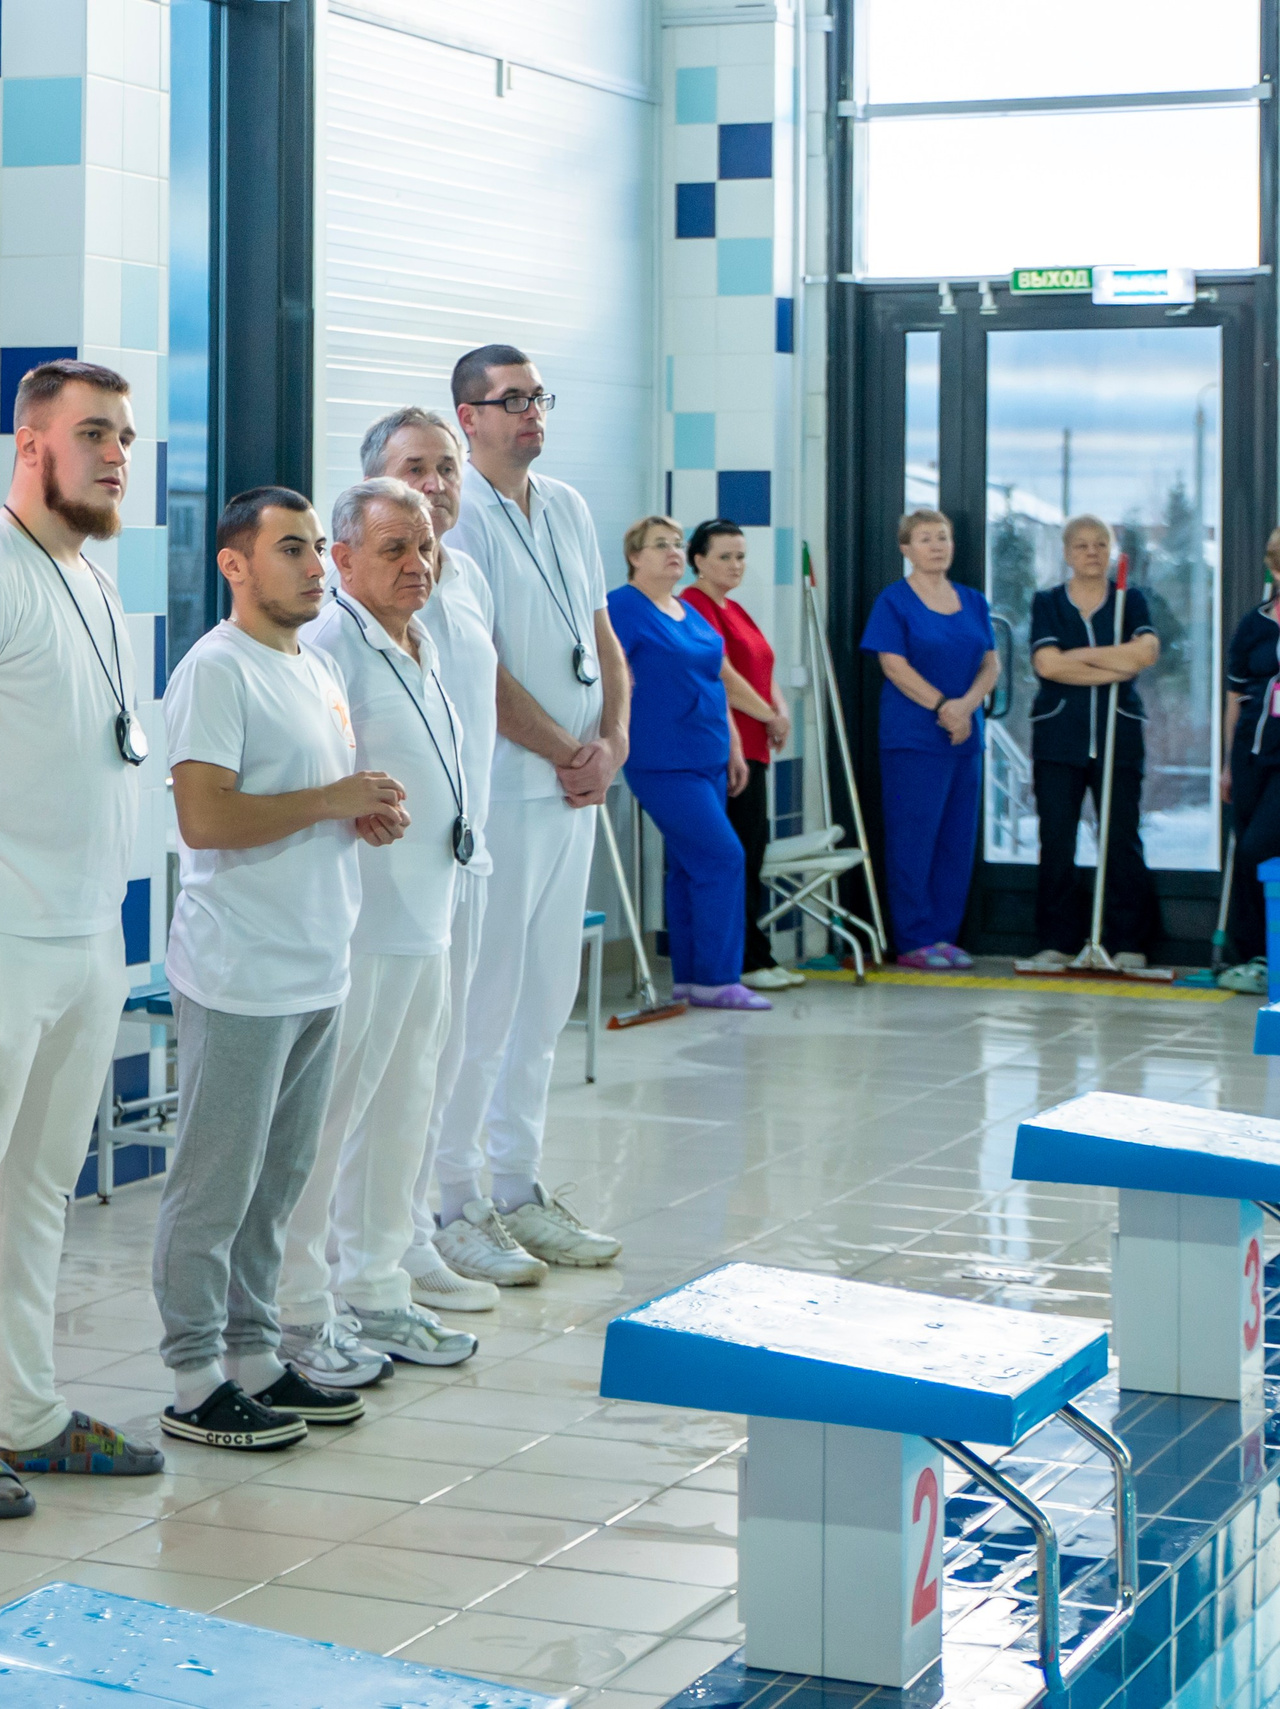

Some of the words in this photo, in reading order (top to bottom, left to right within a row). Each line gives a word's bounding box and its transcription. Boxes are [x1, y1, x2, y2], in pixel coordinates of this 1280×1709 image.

[1018, 270, 1090, 289] ВЫХОД
[1243, 1237, 1261, 1352] 3
[206, 1432, 254, 1445] crocs
[910, 1467, 939, 1628] 2
